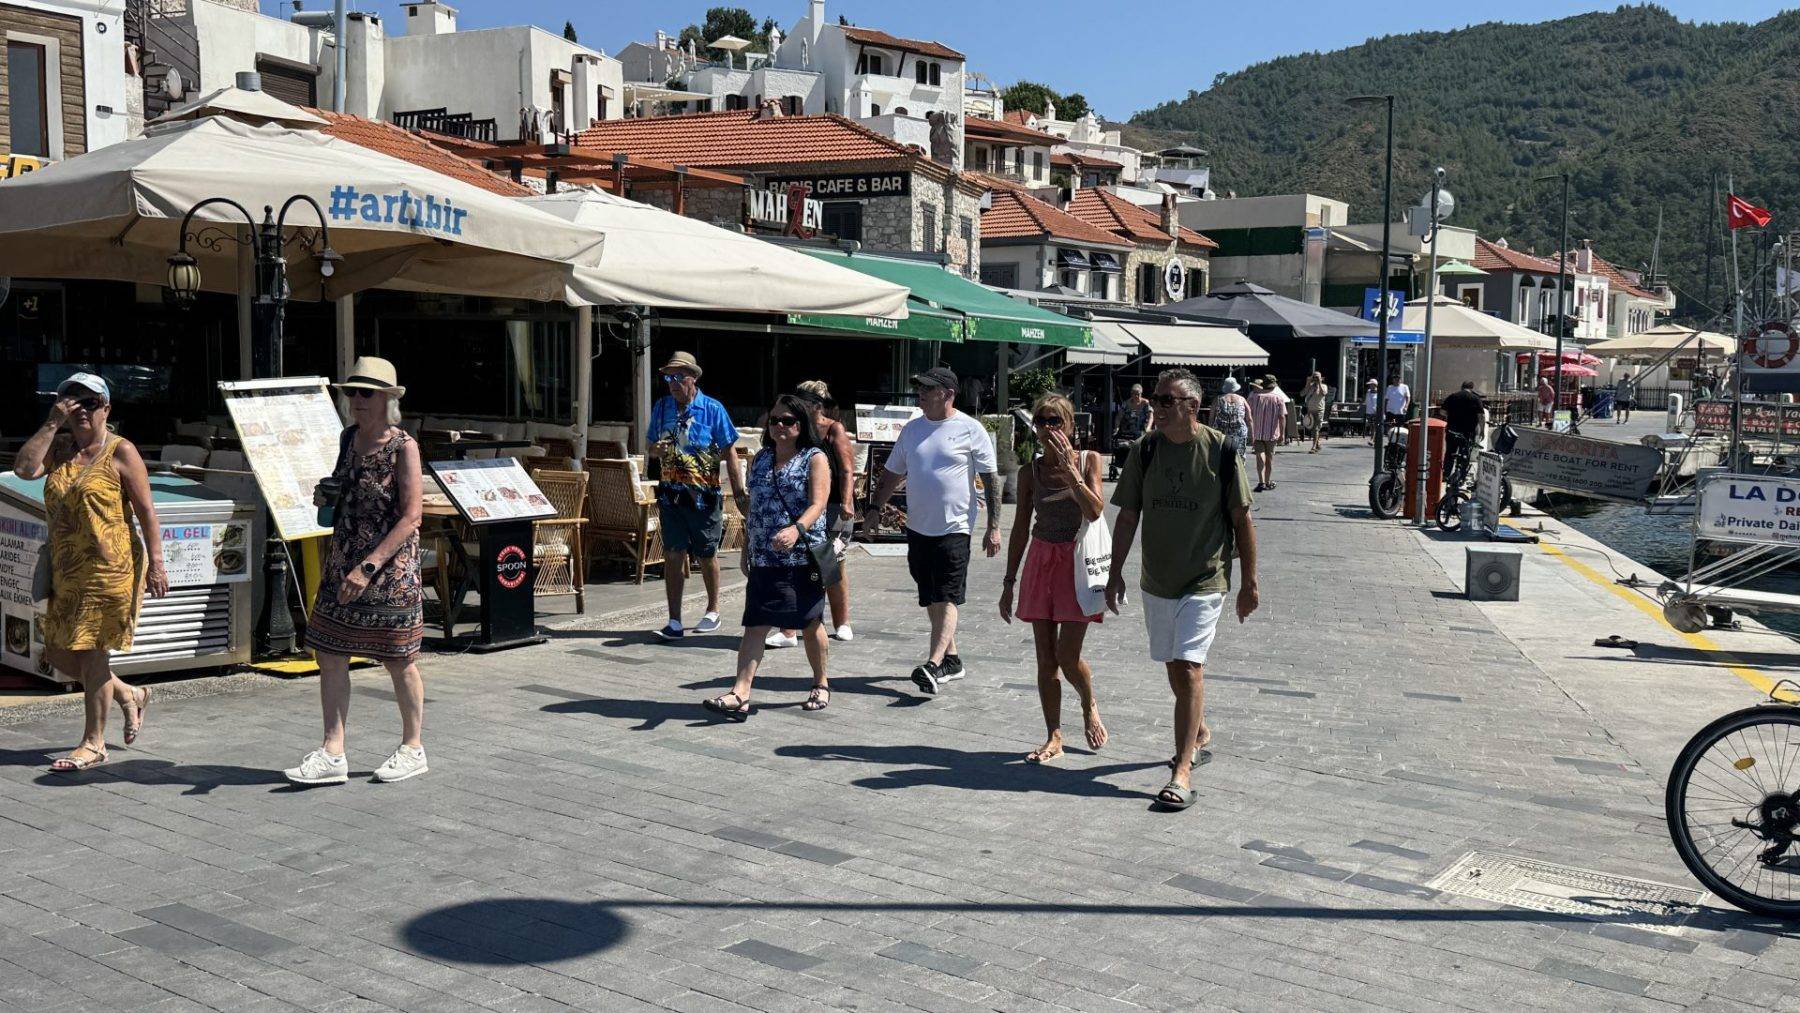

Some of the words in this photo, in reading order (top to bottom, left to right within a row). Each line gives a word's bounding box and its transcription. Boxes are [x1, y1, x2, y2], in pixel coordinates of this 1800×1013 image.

[817, 179, 853, 193] CAFE
[857, 177, 868, 190] &
[871, 176, 902, 192] BAR
[1021, 327, 1045, 339] MAHZEN
[1553, 454, 1581, 465] BOAT
[1585, 458, 1608, 469] FOR
[1610, 463, 1640, 473] RENT
[1729, 485, 1766, 501] LA
[1776, 487, 1800, 503] D
[1728, 516, 1774, 529] Private
[163, 528, 178, 539] AL
[184, 527, 208, 538] GEL
[497, 561, 527, 572] SPOON
